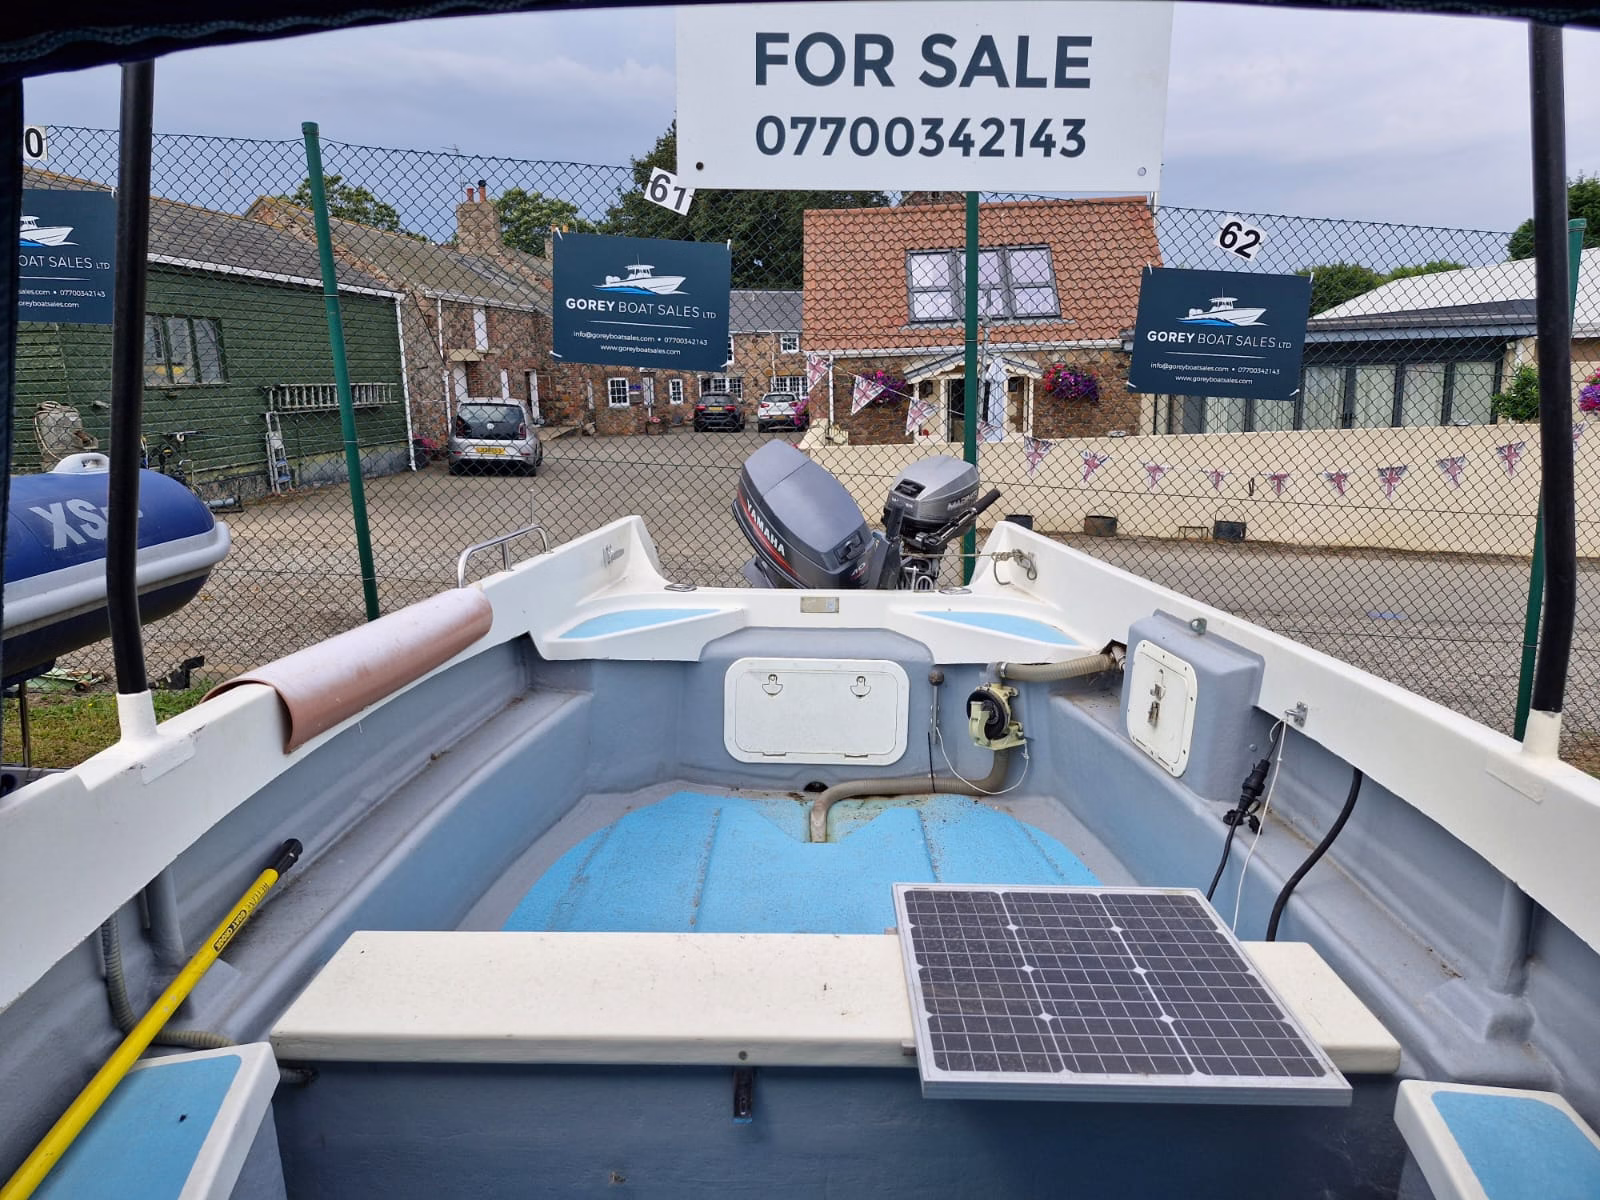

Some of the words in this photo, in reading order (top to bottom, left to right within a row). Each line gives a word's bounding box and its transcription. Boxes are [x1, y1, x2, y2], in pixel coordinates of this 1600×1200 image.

[755, 31, 895, 87] FOR
[918, 33, 1093, 89] SALE
[755, 115, 1087, 158] 07700342143
[650, 173, 686, 211] 61
[1219, 221, 1261, 259] 62
[48, 256, 93, 269] SALES
[96, 262, 110, 270] LTD
[60, 289, 106, 298] 07700342143
[566, 298, 615, 312] GOREY
[618, 301, 654, 315] BOAT
[657, 304, 700, 318] SALES
[702, 311, 717, 319] LTD
[573, 330, 655, 343] info@goreyboatsales.com
[664, 336, 708, 346] 07700342143
[1147, 330, 1195, 344] GOREY
[1197, 333, 1233, 345] BOAT
[1235, 335, 1276, 348] SALES
[1278, 341, 1292, 349] LTD
[600, 344, 681, 356] www.goreyboatsales.com
[1150, 362, 1229, 374] info@goreyboatsales.com
[1237, 366, 1280, 376] 07700342143
[1175, 375, 1253, 386] www.goreyboatsales.com
[28, 498, 109, 551] XS
[745, 499, 786, 557] YAMAHA
